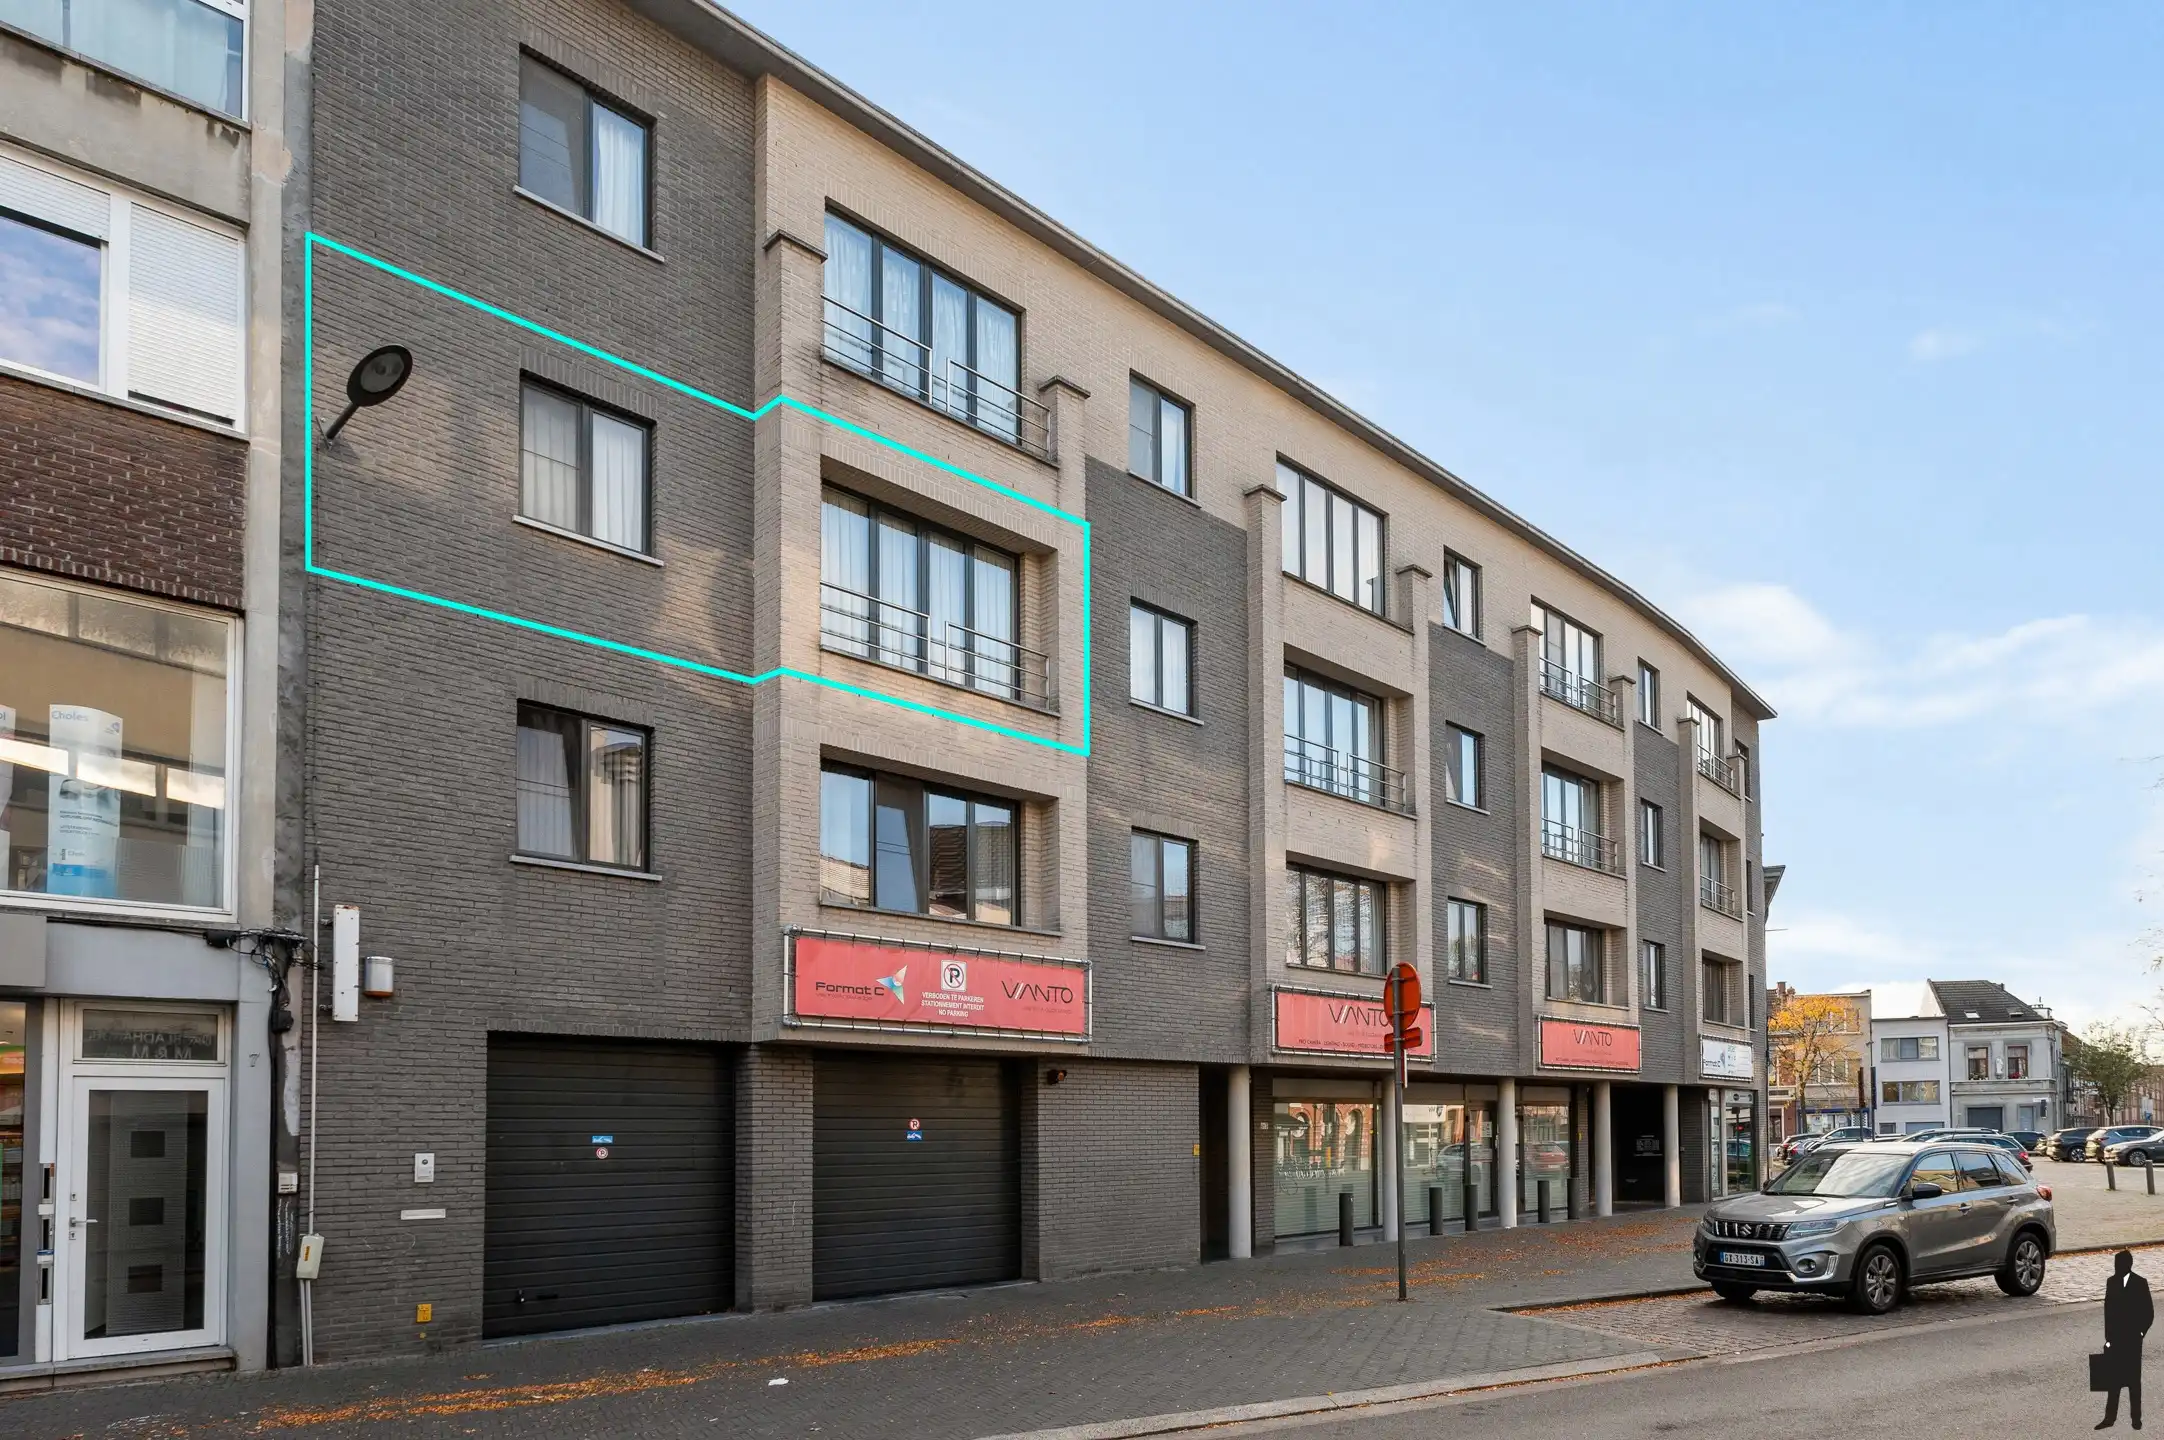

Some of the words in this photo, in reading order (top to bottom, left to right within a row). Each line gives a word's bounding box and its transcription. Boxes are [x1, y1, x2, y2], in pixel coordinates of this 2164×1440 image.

[815, 981, 872, 995] Format
[874, 986, 885, 996] C
[921, 992, 950, 1000] VERBODEN
[958, 995, 984, 1003] PARKEREN
[921, 1000, 963, 1009] STATIONNEMENT
[963, 1003, 985, 1011] INTERDIT
[947, 1010, 969, 1018] PARKING
[249, 1053, 260, 1067] 7
